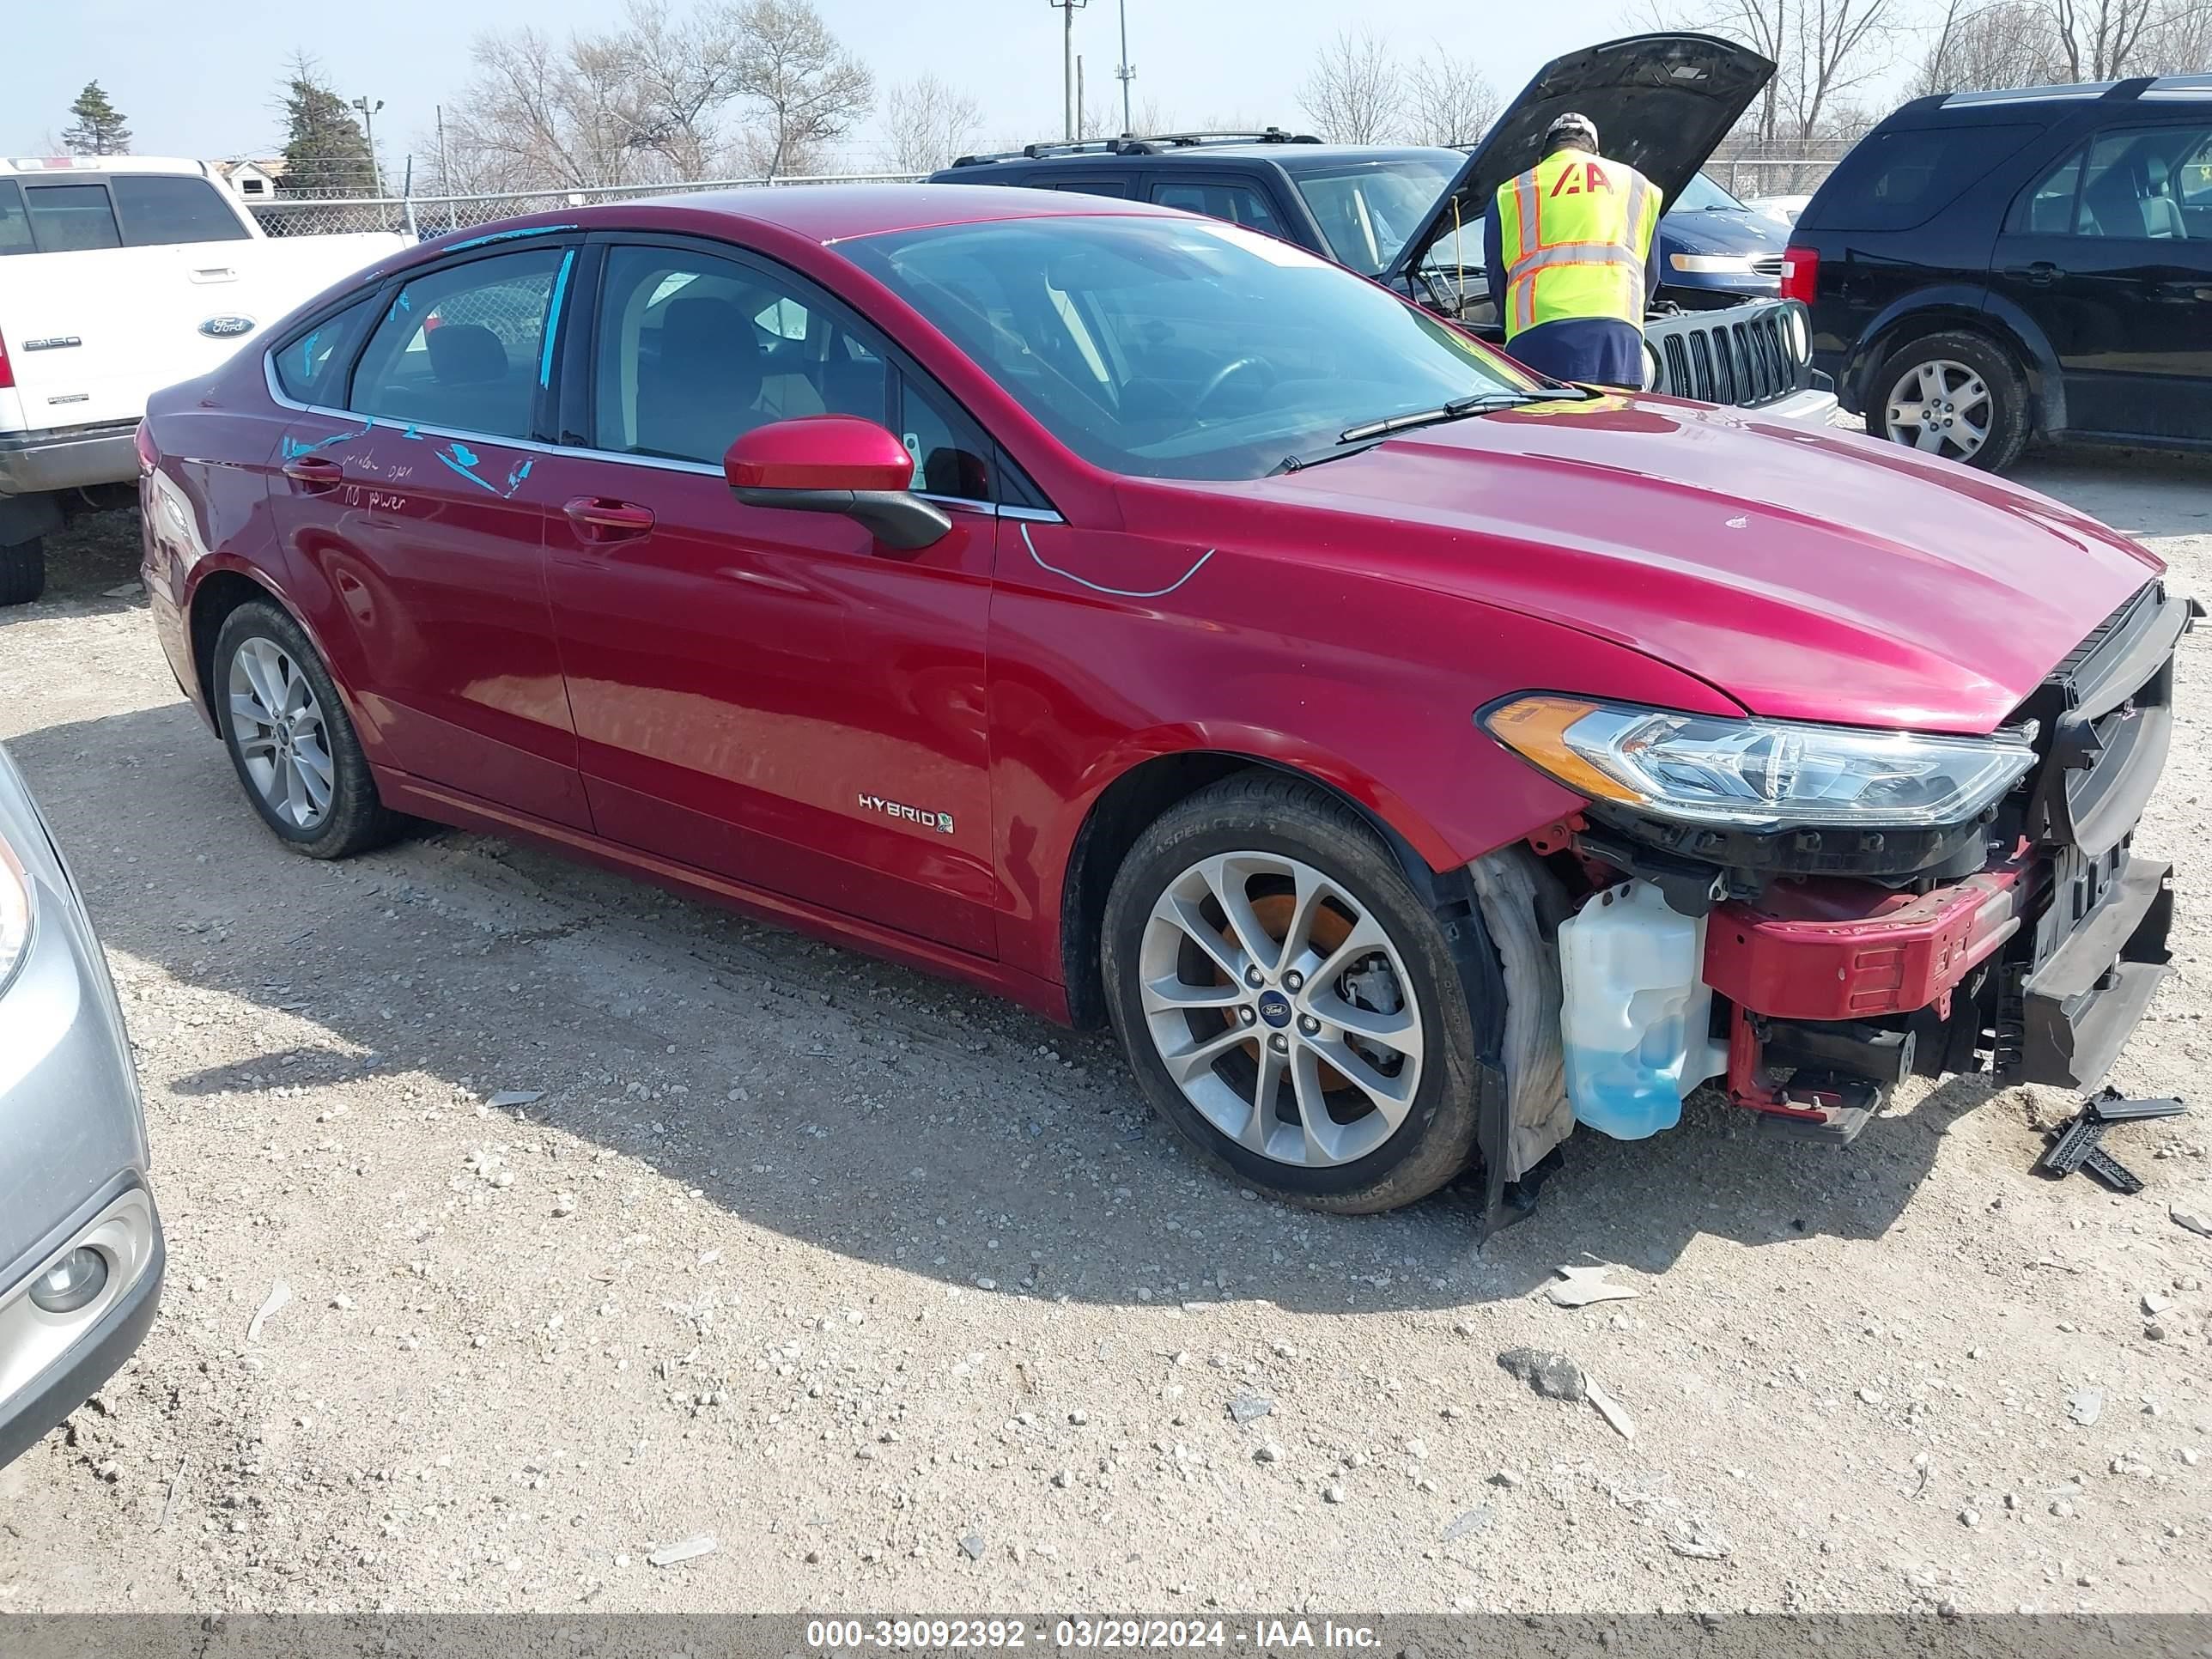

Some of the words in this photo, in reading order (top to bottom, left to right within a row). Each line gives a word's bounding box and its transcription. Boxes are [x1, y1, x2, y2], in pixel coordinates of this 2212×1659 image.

[211, 317, 246, 334] Ford
[368, 492, 406, 518] power
[859, 793, 935, 827] HYBRID
